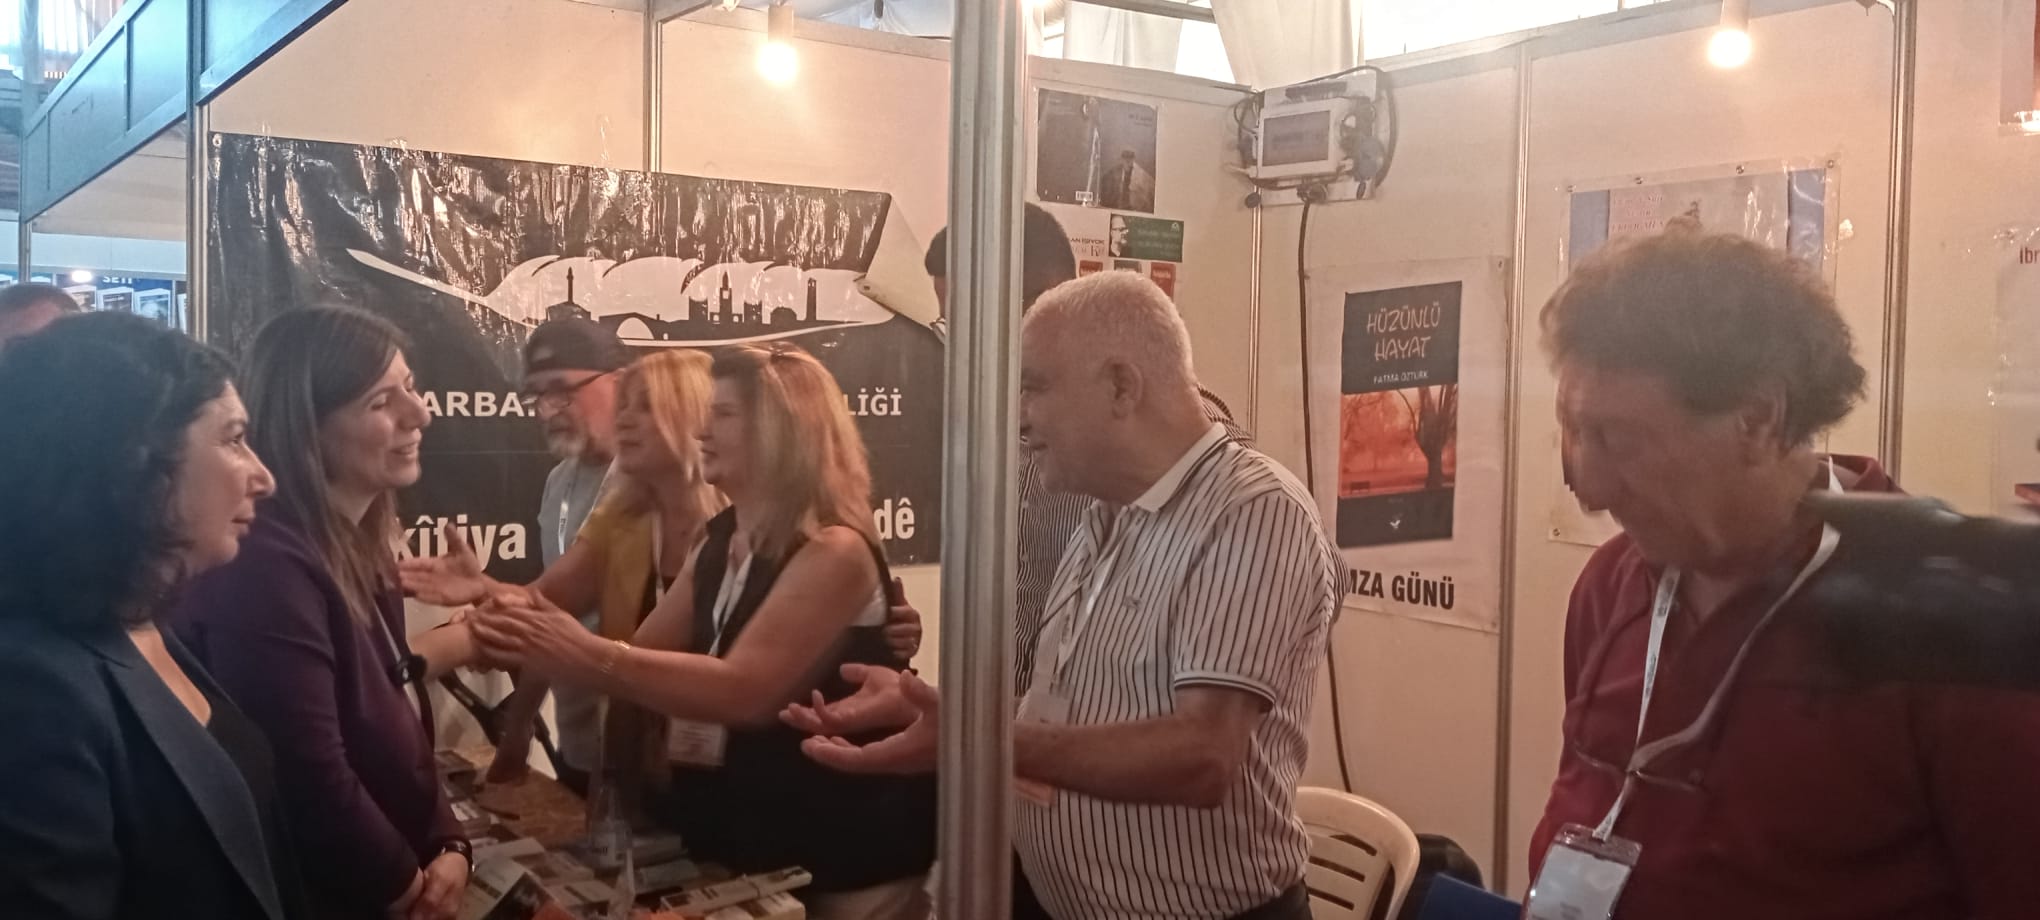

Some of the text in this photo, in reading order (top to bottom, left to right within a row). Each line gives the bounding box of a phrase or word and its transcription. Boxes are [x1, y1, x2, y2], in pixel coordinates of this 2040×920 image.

[1366, 301, 1441, 334] HÜZÜNLÜ
[1375, 336, 1431, 362] HAYAT
[873, 497, 915, 540] dê
[1391, 570, 1455, 610] GÜNÜ
